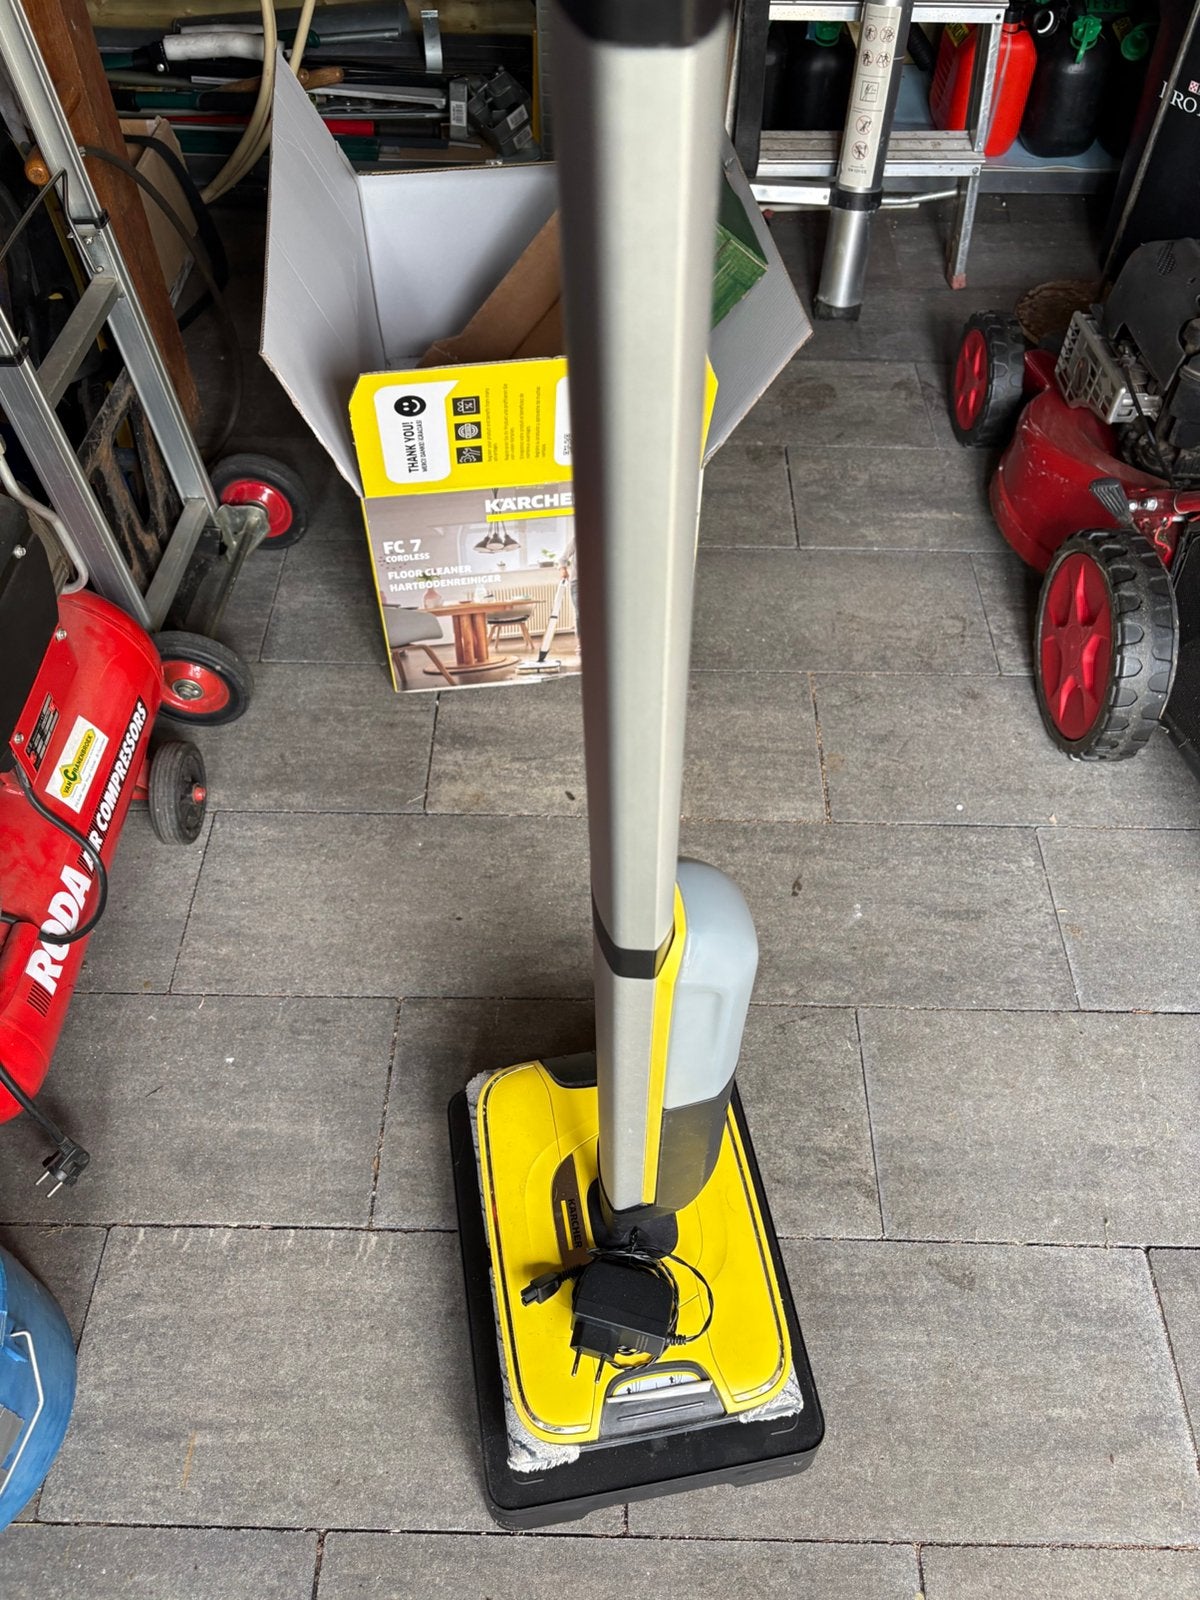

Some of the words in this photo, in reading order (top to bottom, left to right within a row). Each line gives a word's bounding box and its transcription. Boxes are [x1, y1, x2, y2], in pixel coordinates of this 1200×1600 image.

[401, 421, 415, 443] YOU!
[404, 444, 419, 473] THANK
[383, 540, 405, 555] FC
[410, 539, 421, 552] 7
[385, 552, 430, 563] CORDLESS
[388, 569, 424, 580] FLOOR
[424, 564, 473, 577] CLEANER
[389, 574, 502, 593] HARTBODENREINIGER
[63, 780, 73, 794] VAN
[25, 865, 92, 996] RODA
[96, 701, 148, 832] COMPRESSORS
